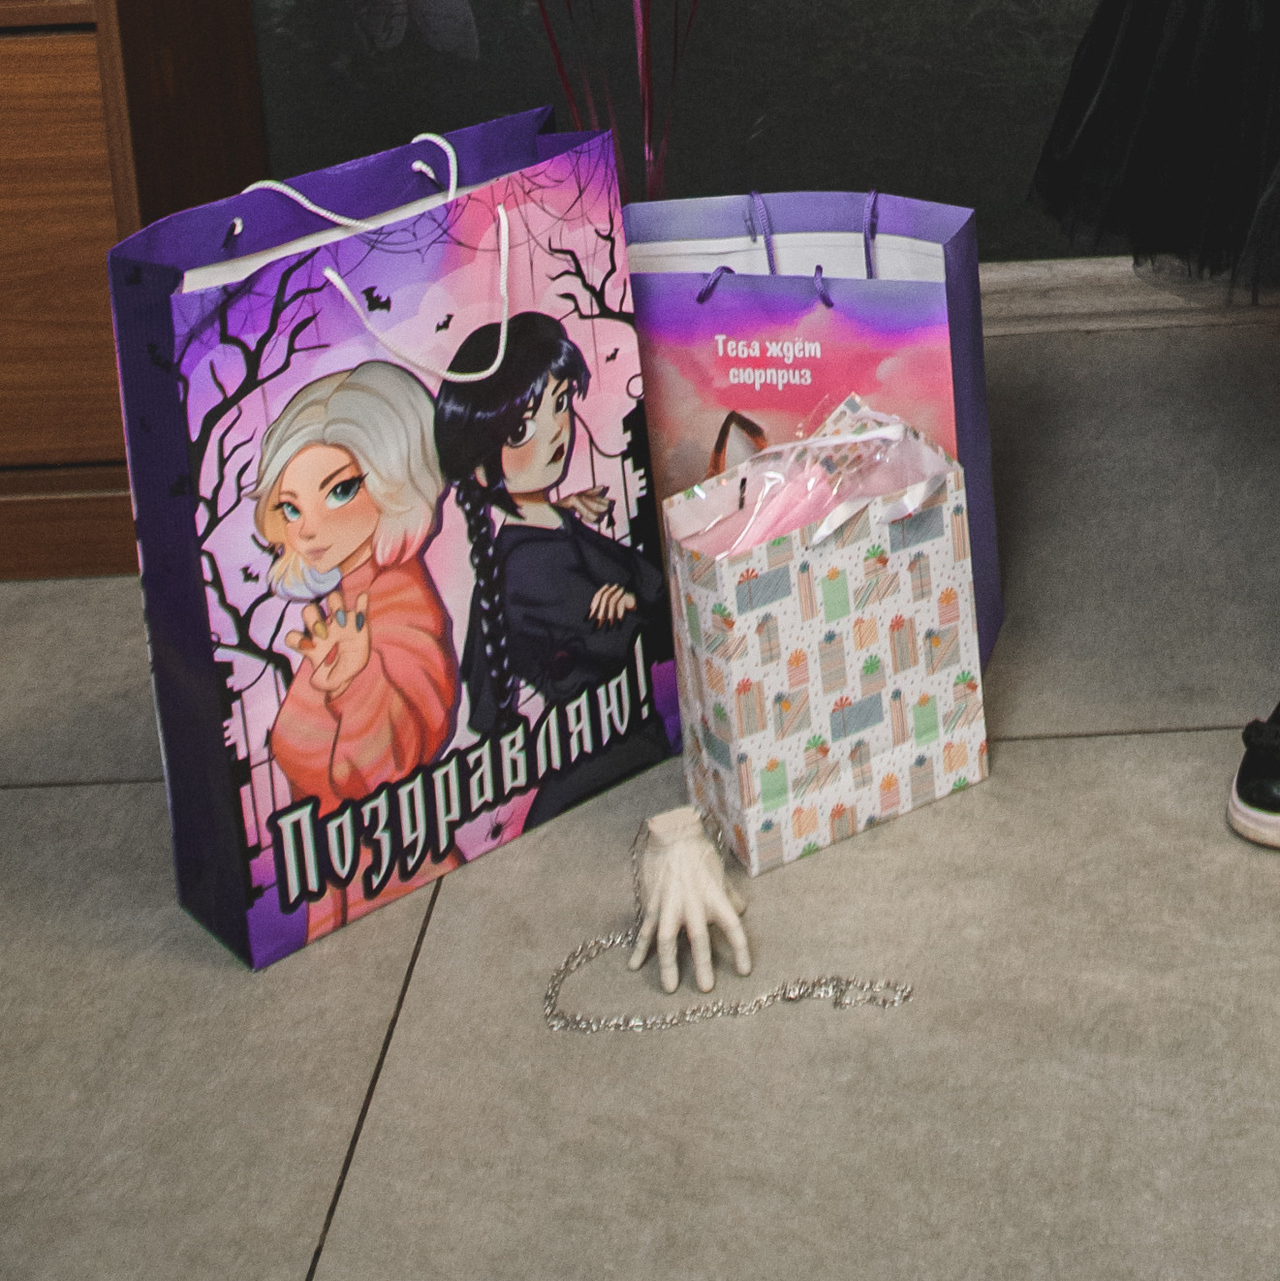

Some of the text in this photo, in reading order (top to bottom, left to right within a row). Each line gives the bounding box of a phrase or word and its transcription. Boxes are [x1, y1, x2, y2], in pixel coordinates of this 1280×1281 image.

[714, 334, 821, 364] Тебя ждёт
[728, 367, 812, 391] сюрприз
[275, 632, 652, 905] Поздравляю!
